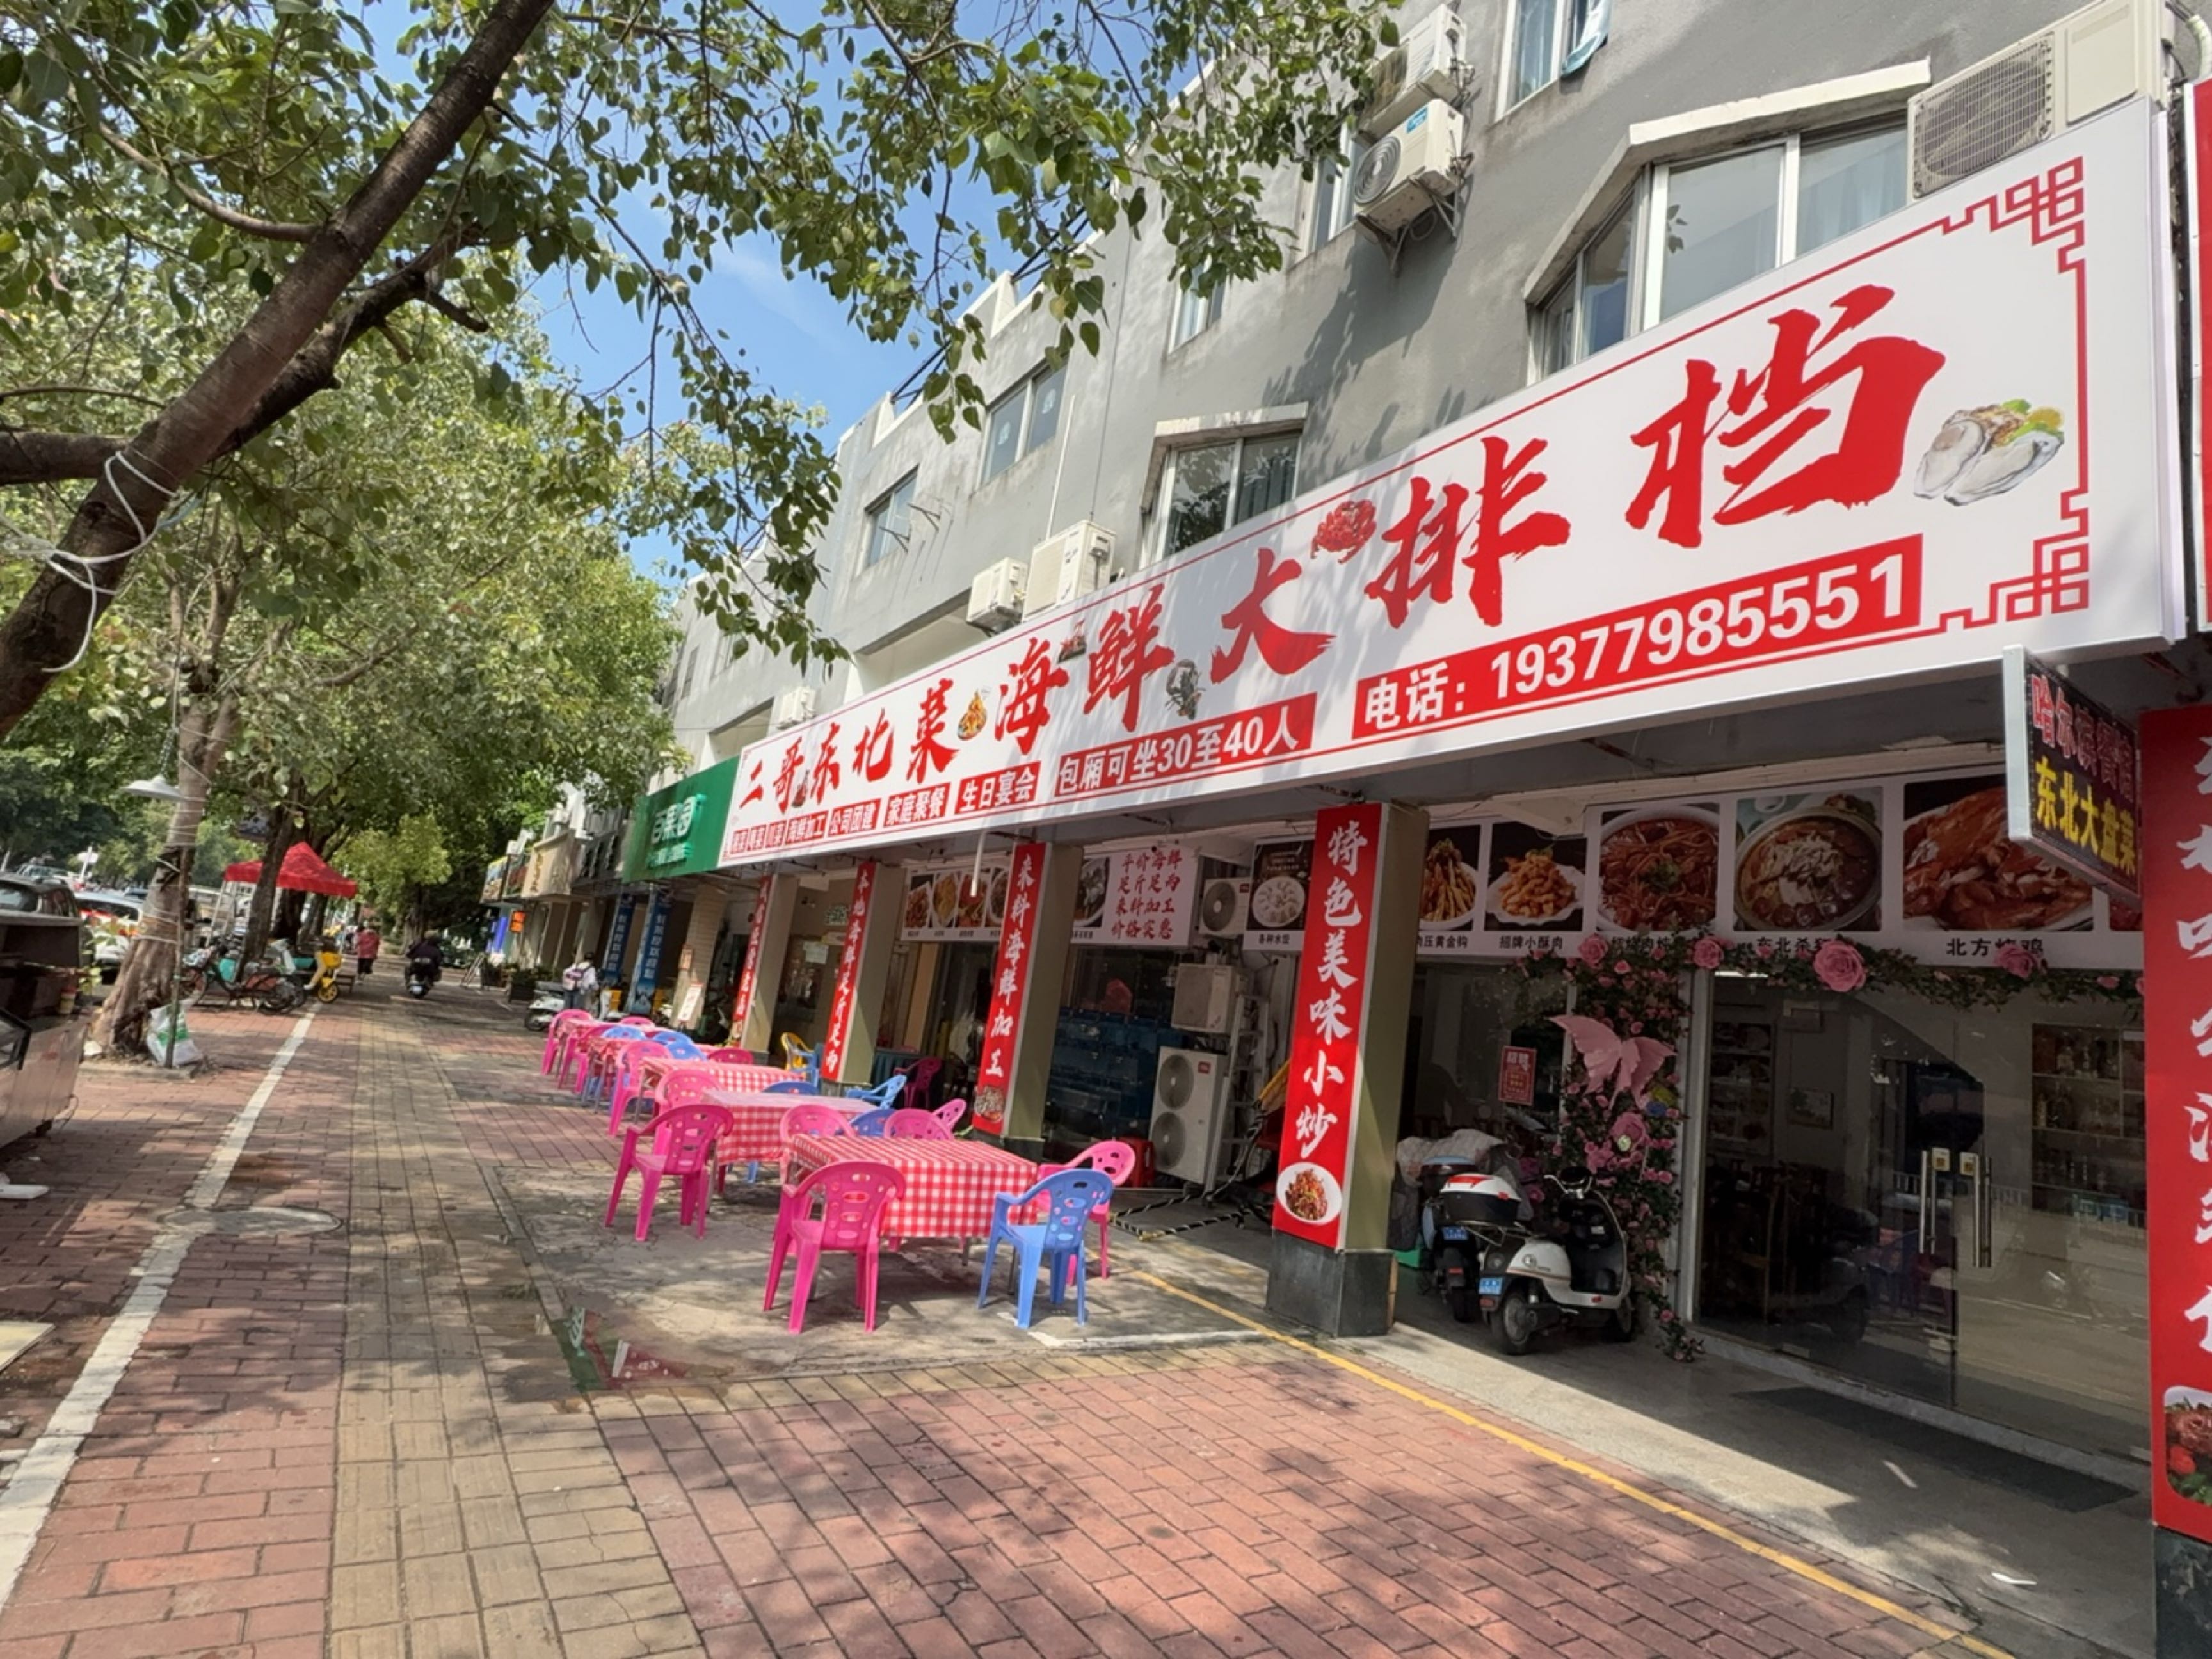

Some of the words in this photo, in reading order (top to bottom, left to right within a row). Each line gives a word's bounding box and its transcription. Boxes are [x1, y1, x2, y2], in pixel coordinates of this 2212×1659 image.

[1059, 714, 1299, 794] 包厢可坐30至40人
[886, 789, 946, 824] 家庭聚餐
[961, 768, 1038, 812] 生日宴会
[830, 802, 877, 835] 公司团建
[1121, 848, 1183, 873] 平价海鲜
[1118, 872, 1181, 895] 足斤足两
[1115, 896, 1176, 917] 来料加工
[1111, 918, 1173, 940] 价格实惠
[1499, 935, 1563, 950] 招牌小酥肉
[824, 869, 870, 1073] 本地海鲜足斤足两
[984, 853, 1036, 1078] 来料海鲜加工
[1295, 819, 1368, 1158] 特色美味小炒
